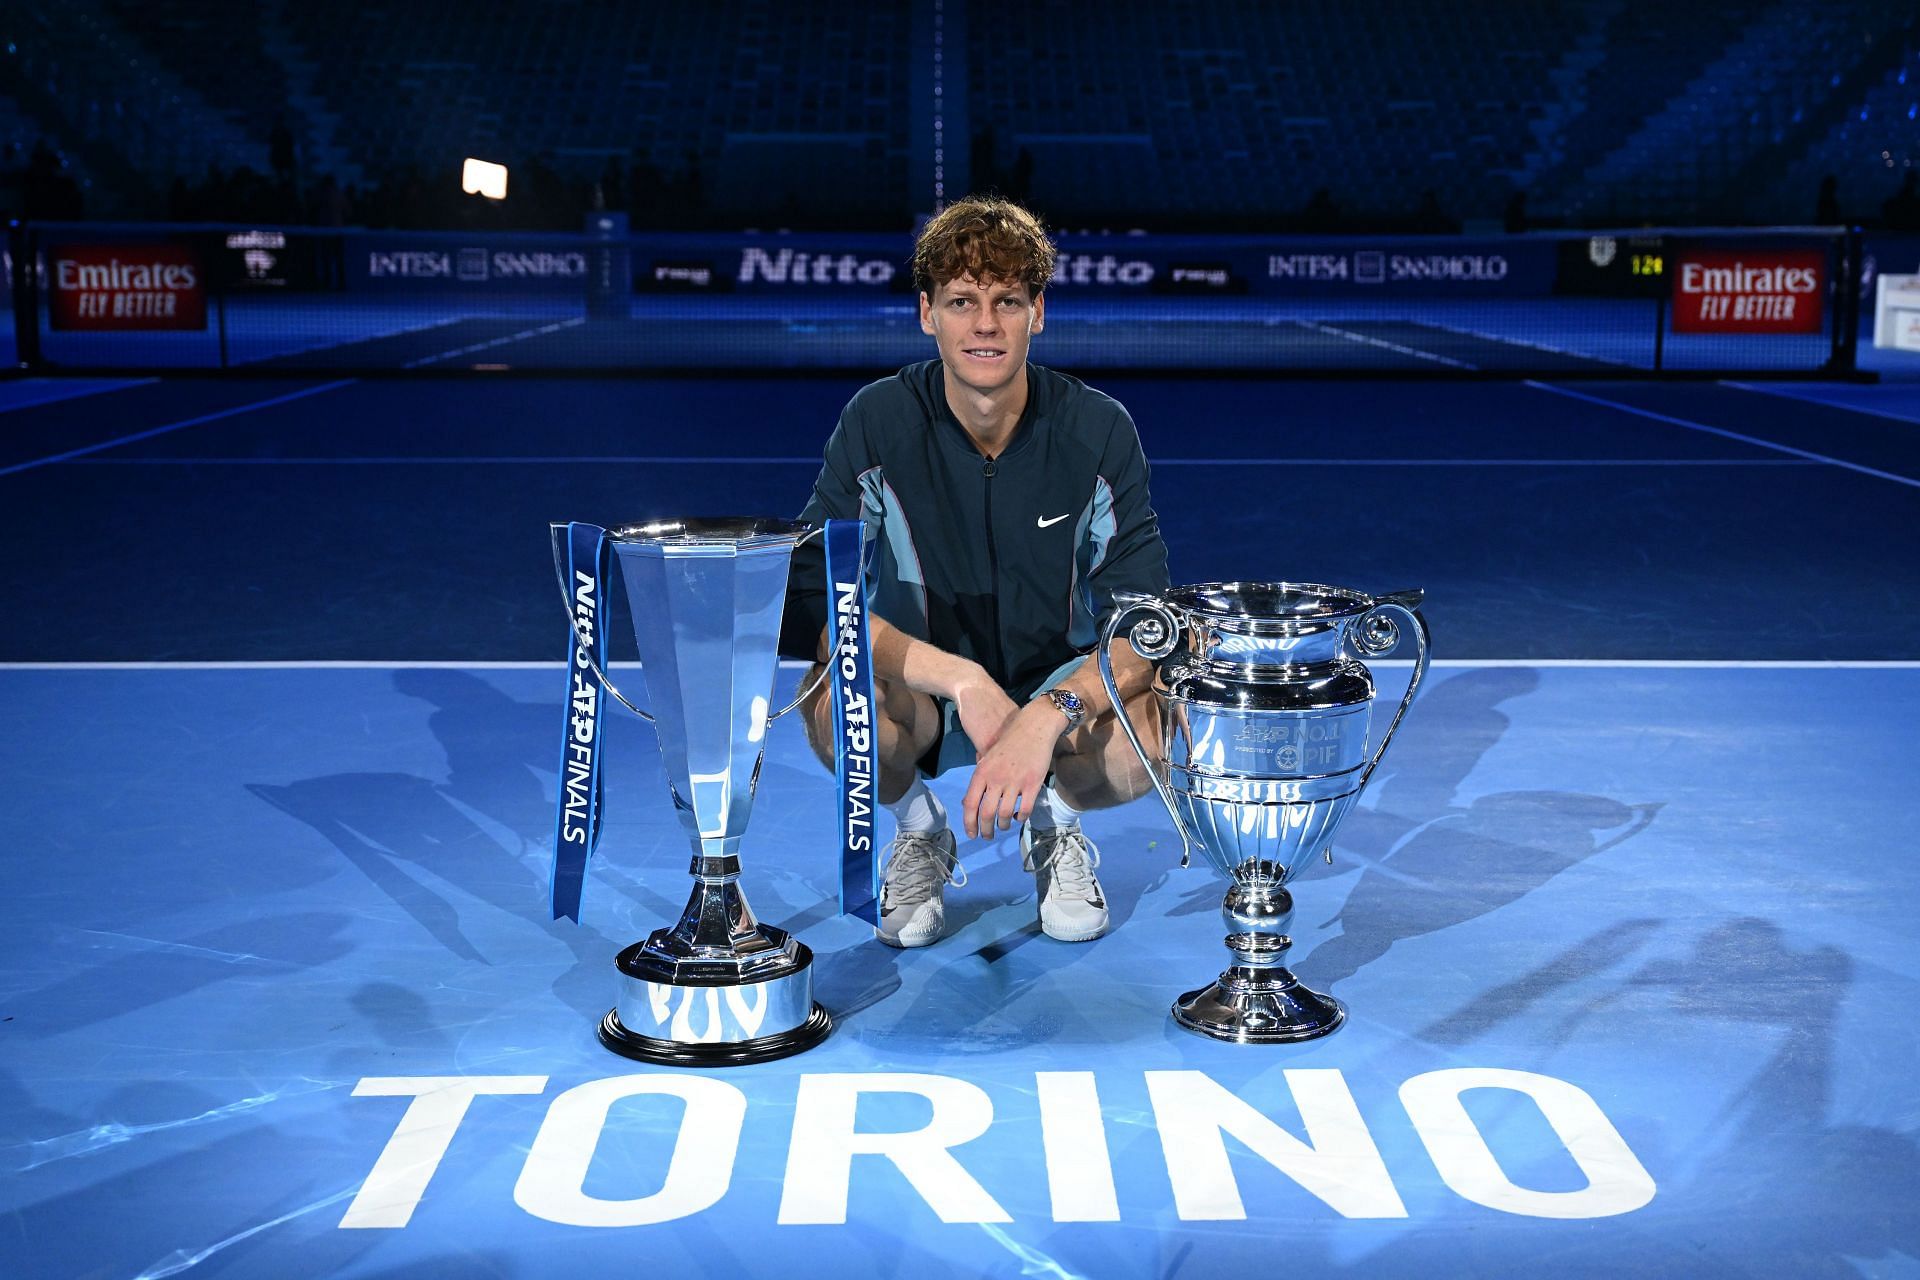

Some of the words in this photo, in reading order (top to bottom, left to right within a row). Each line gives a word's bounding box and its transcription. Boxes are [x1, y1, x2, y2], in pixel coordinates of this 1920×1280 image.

[56, 258, 196, 291] Emirates
[369, 251, 452, 278] INTESA
[737, 247, 895, 284] Nitto
[1053, 253, 1156, 285] itto
[1268, 254, 1349, 280] INTESA
[1681, 262, 1816, 294] Emirates
[78, 292, 109, 318] FLY
[112, 292, 177, 318] BETTER
[1700, 296, 1730, 321] FLY
[1733, 296, 1796, 321] BETTER
[575, 570, 596, 669] Nitto
[835, 582, 861, 681] Nitto
[571, 671, 596, 743] ATP
[844, 682, 870, 752] ATP
[1304, 745, 1337, 766] PIF
[563, 743, 592, 845] FINALS
[848, 754, 871, 851] FINALS
[338, 1067, 1657, 1229] TORINO
